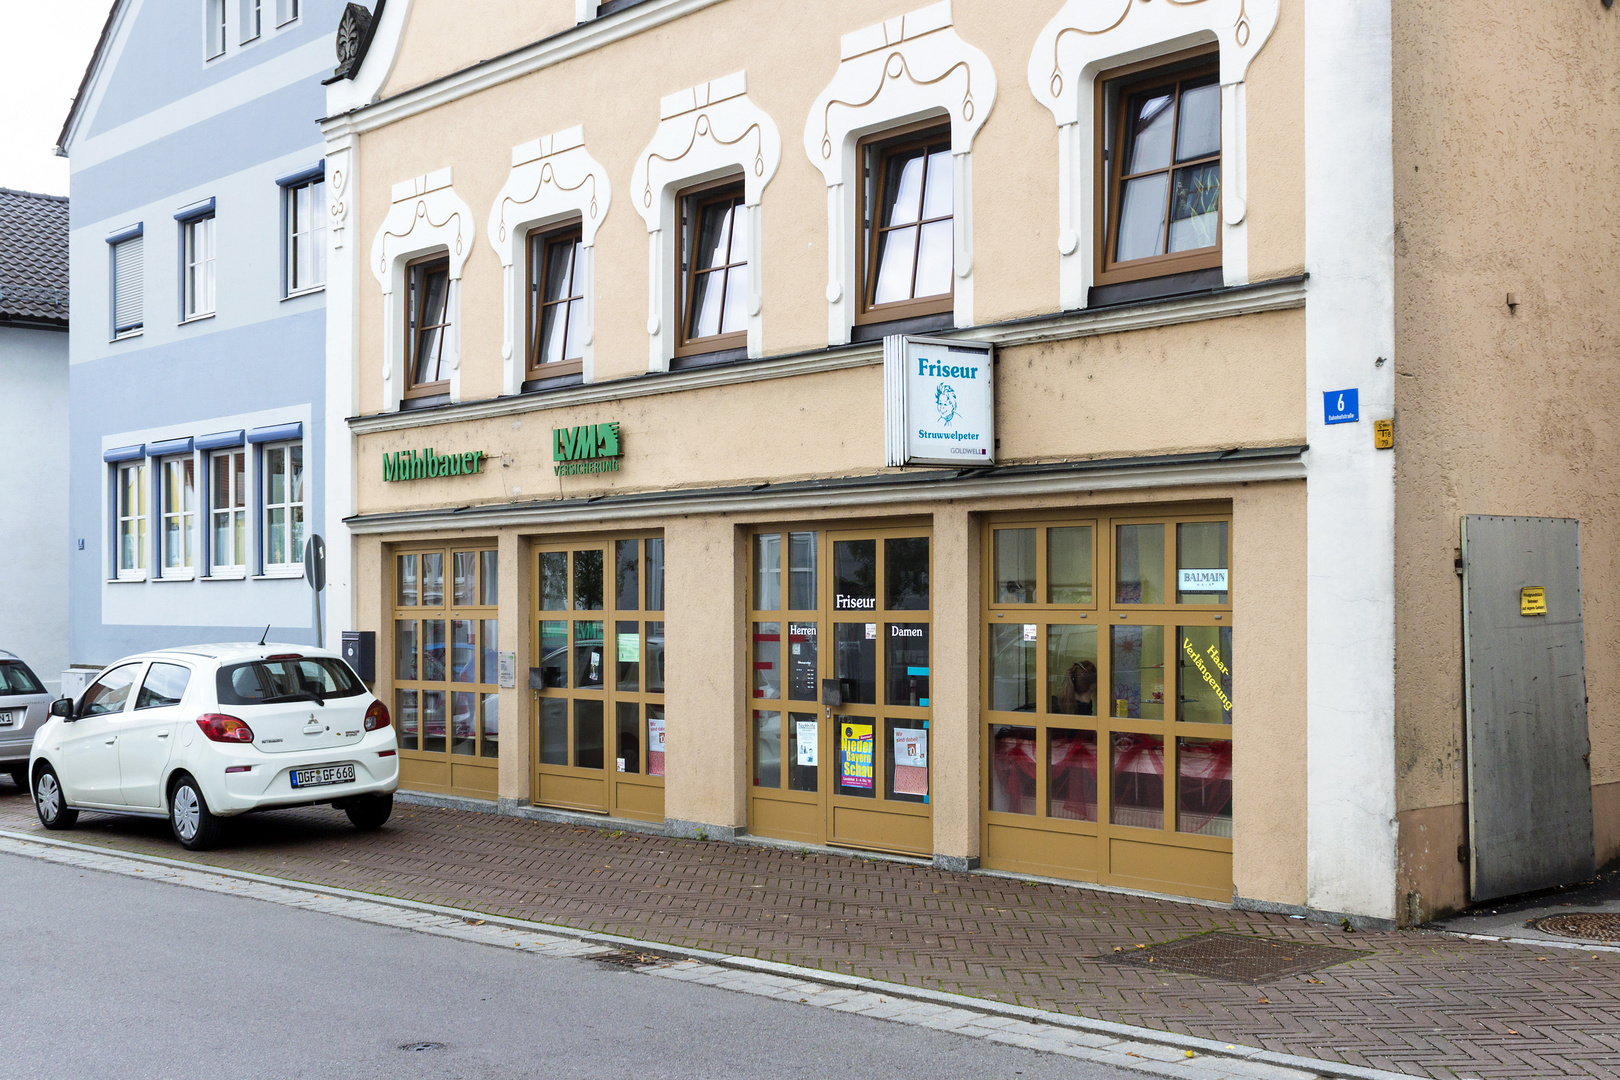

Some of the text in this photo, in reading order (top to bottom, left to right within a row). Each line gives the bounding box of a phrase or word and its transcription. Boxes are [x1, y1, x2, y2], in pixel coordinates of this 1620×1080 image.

[918, 358, 978, 379] Friseur
[1337, 393, 1345, 412] 6
[553, 424, 597, 462] LVM
[918, 429, 980, 441] Struwwelpeter
[950, 447, 982, 455] GOLDWELL
[382, 447, 483, 482] Mühlbauer
[553, 460, 619, 477] VERSICHERUNG
[1183, 572, 1225, 582] BALMAIN
[836, 594, 876, 609] Friseur
[790, 624, 817, 636] Herren
[891, 625, 923, 637] Damen
[1206, 644, 1229, 677] Haar-
[1183, 637, 1232, 712] Verlängerung
[841, 738, 873, 753] Nieder
[846, 751, 872, 763] Bayern
[297, 766, 354, 783] DGF GF 668
[844, 762, 873, 778] Schau
